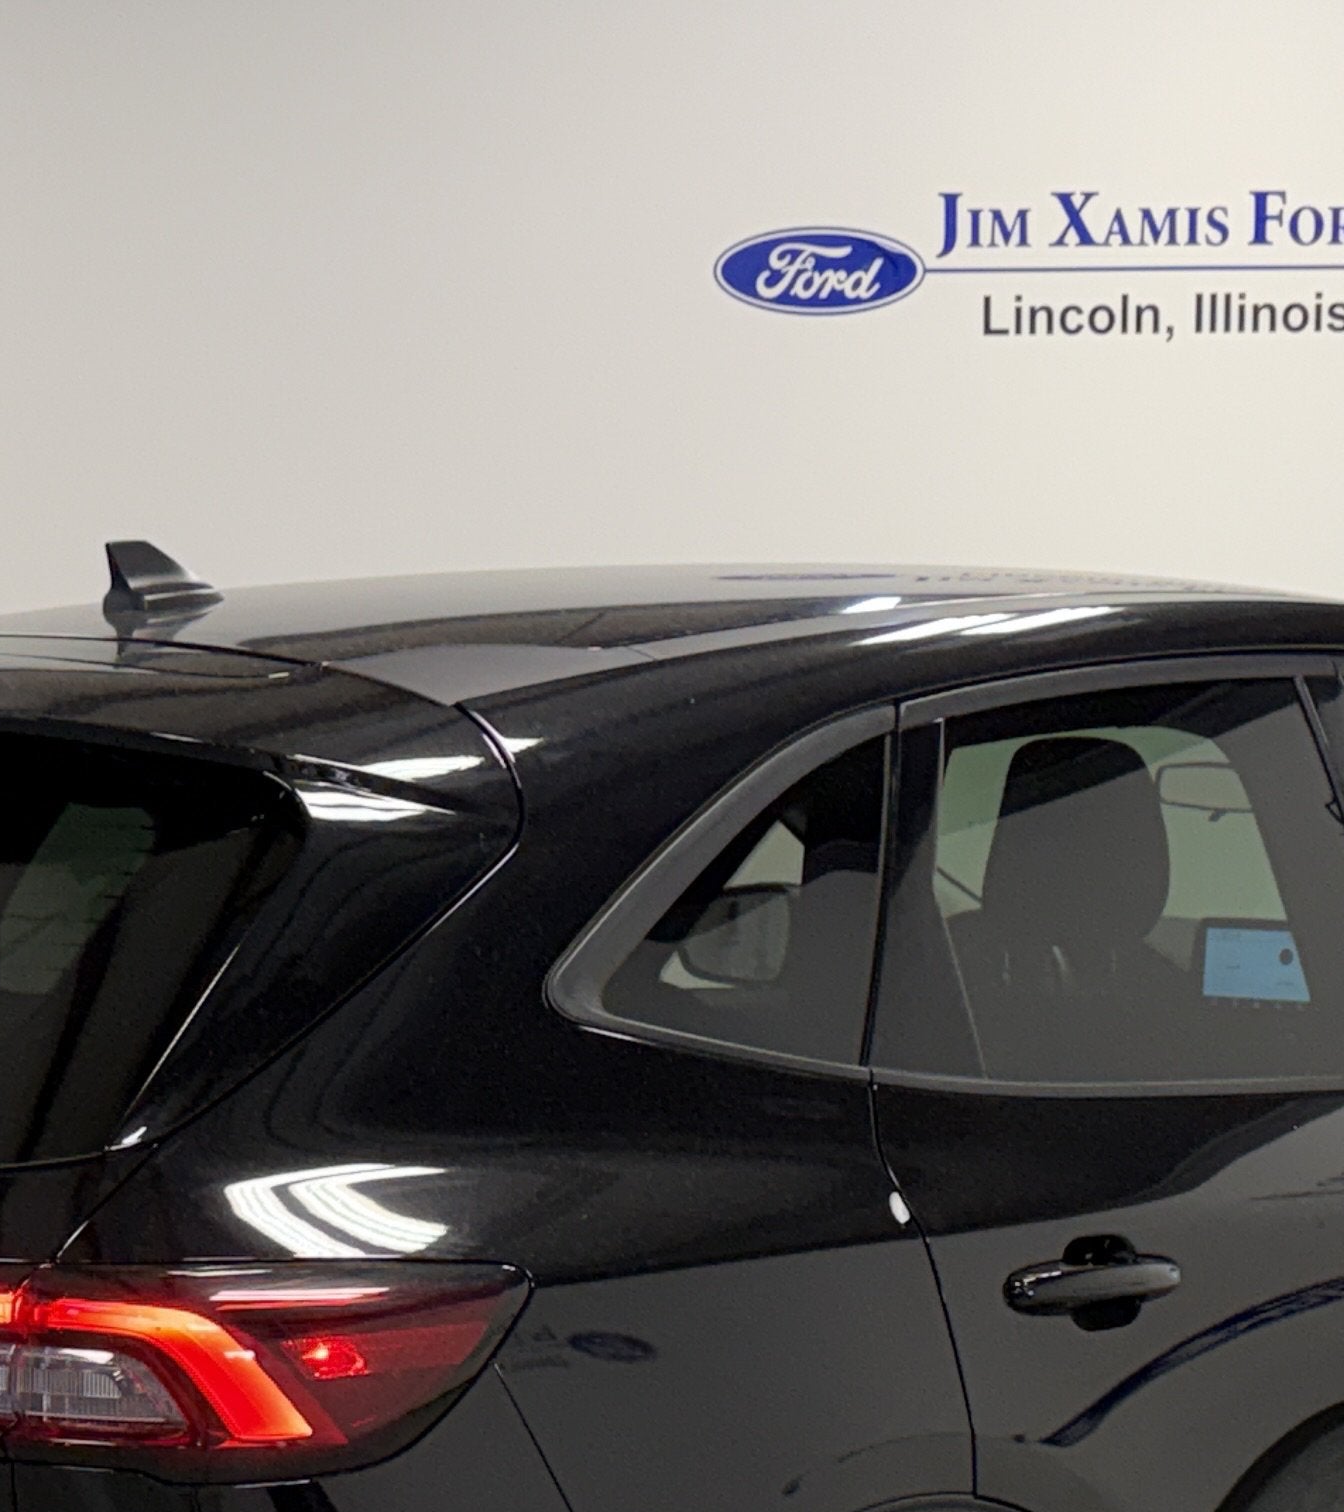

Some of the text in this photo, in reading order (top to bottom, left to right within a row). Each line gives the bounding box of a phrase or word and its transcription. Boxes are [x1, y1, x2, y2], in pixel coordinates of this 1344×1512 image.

[937, 192, 1029, 258] JIM
[1050, 192, 1229, 247] XAMIS
[755, 242, 884, 300] Ford
[983, 294, 1174, 341] Lincoln,
